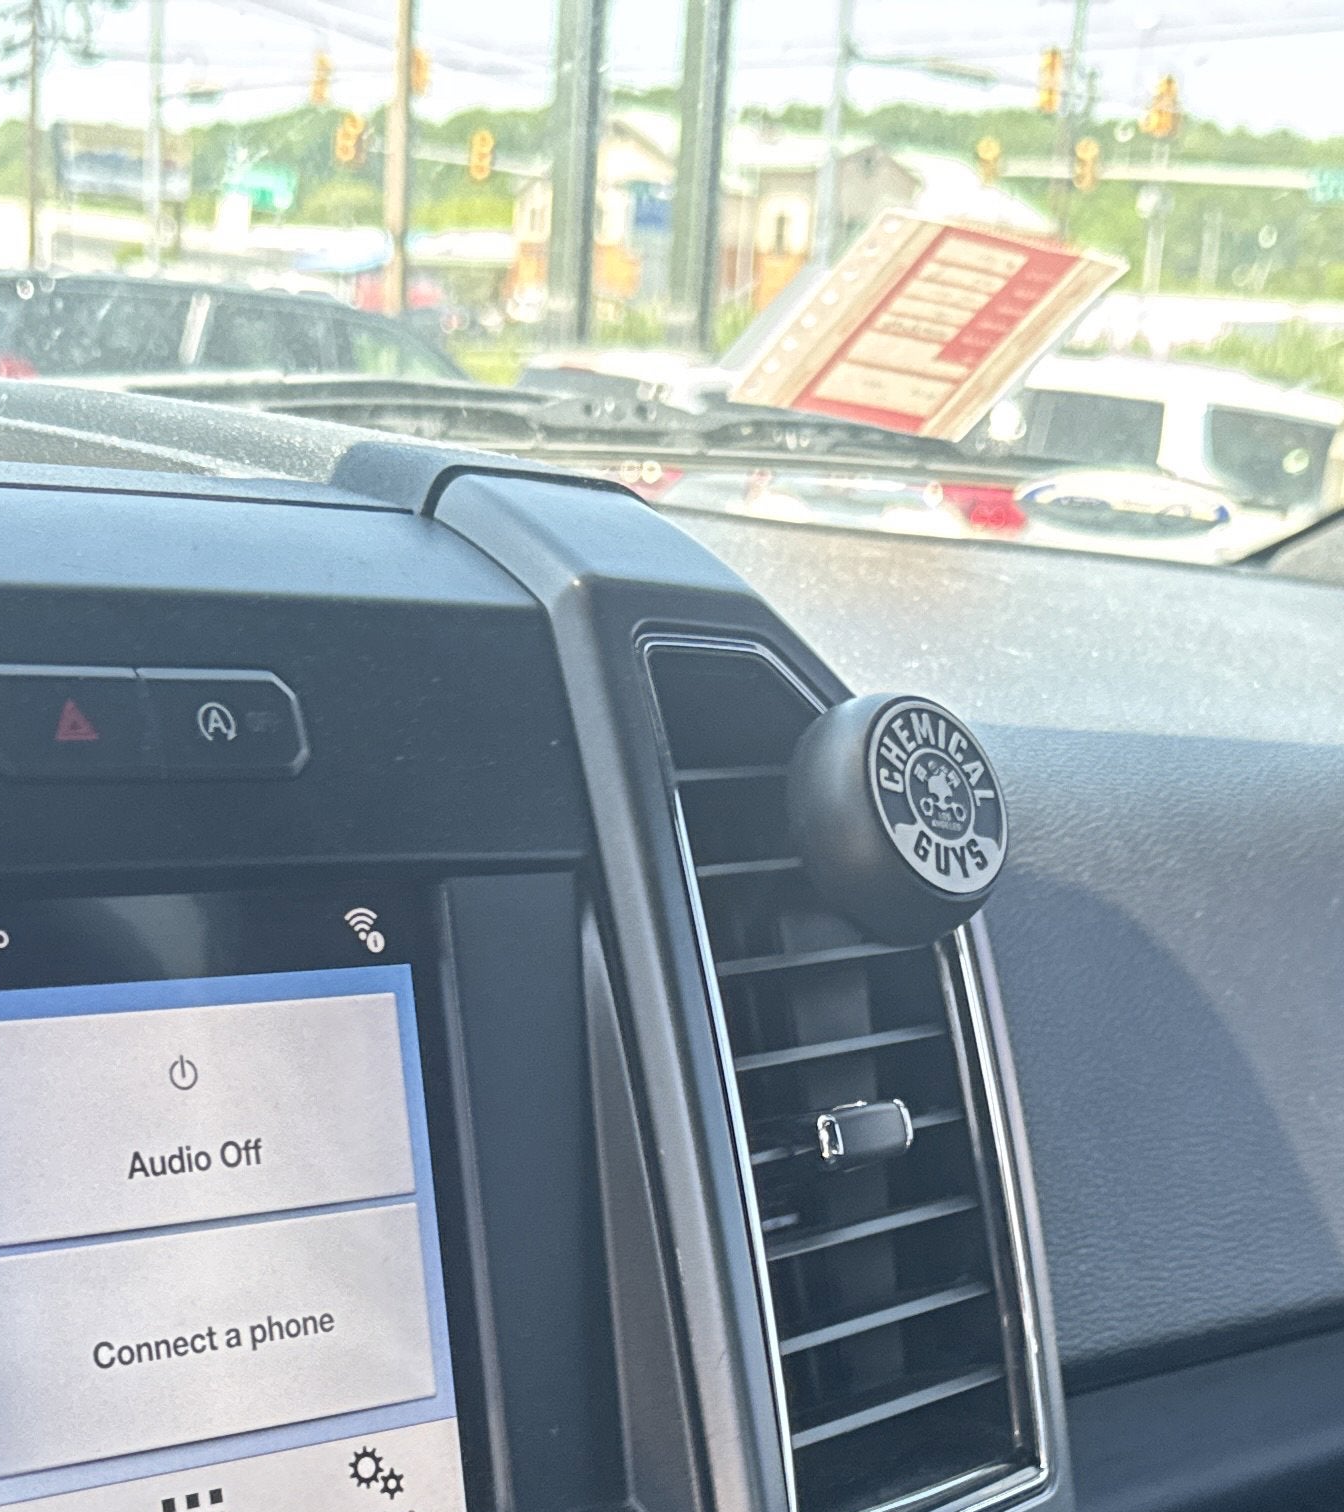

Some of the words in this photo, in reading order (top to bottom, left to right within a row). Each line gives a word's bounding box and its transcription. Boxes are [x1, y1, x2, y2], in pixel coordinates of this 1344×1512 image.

[879, 712, 995, 807] CHEMICAL
[913, 830, 988, 878] GUYS
[127, 1145, 212, 1180] Audio
[219, 1137, 262, 1169] Off
[92, 1326, 219, 1370] Connect
[225, 1327, 242, 1349] a
[249, 1312, 335, 1352] phone
